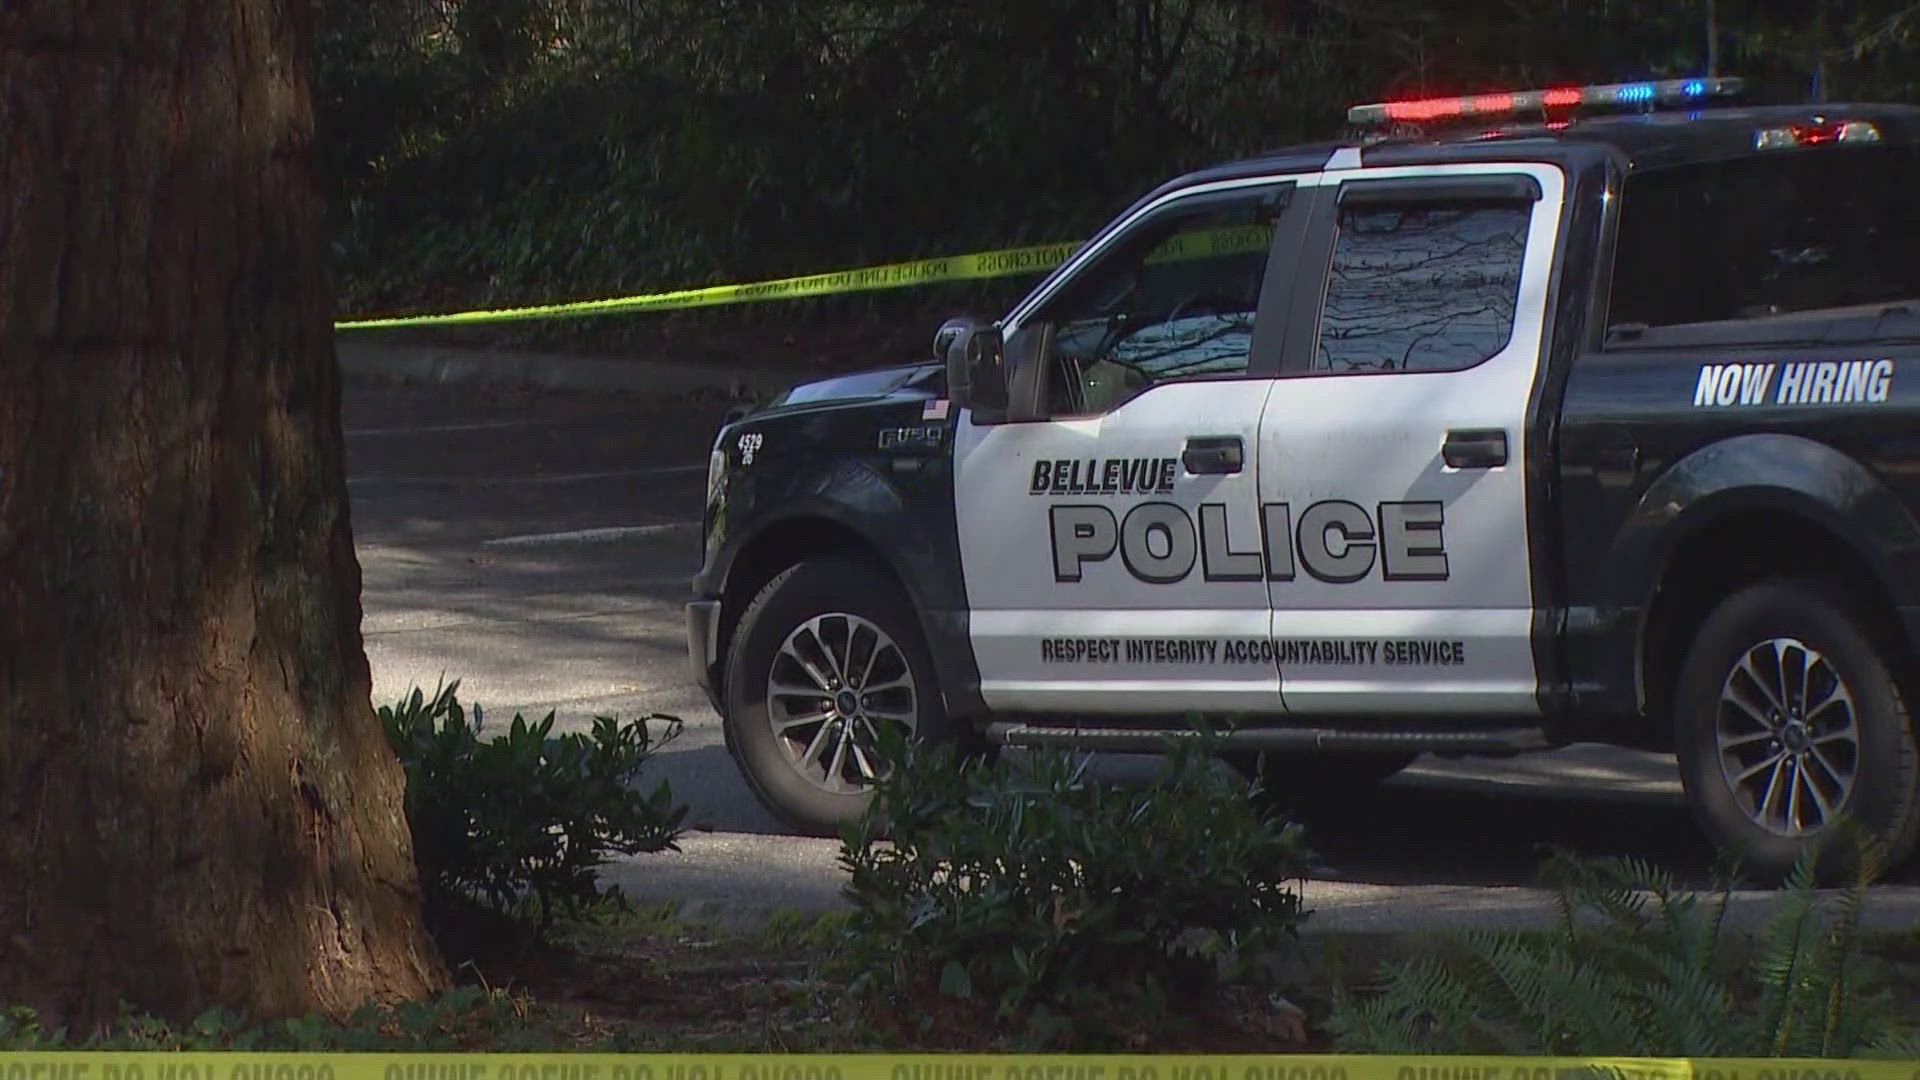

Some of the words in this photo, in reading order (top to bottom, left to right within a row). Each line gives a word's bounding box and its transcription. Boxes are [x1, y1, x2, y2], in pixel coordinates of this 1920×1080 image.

[1693, 363, 1776, 407] NOW
[1776, 359, 1894, 405] HIRING
[737, 433, 762, 450] 4529
[1029, 458, 1177, 495] BELLEVUE
[1048, 500, 1450, 584] POLICE
[1041, 638, 1120, 663] RESPECT
[1126, 639, 1217, 664] INTEGRITY
[1223, 640, 1378, 665] ACCOUNTABILITY
[1384, 641, 1465, 665] SERVICE
